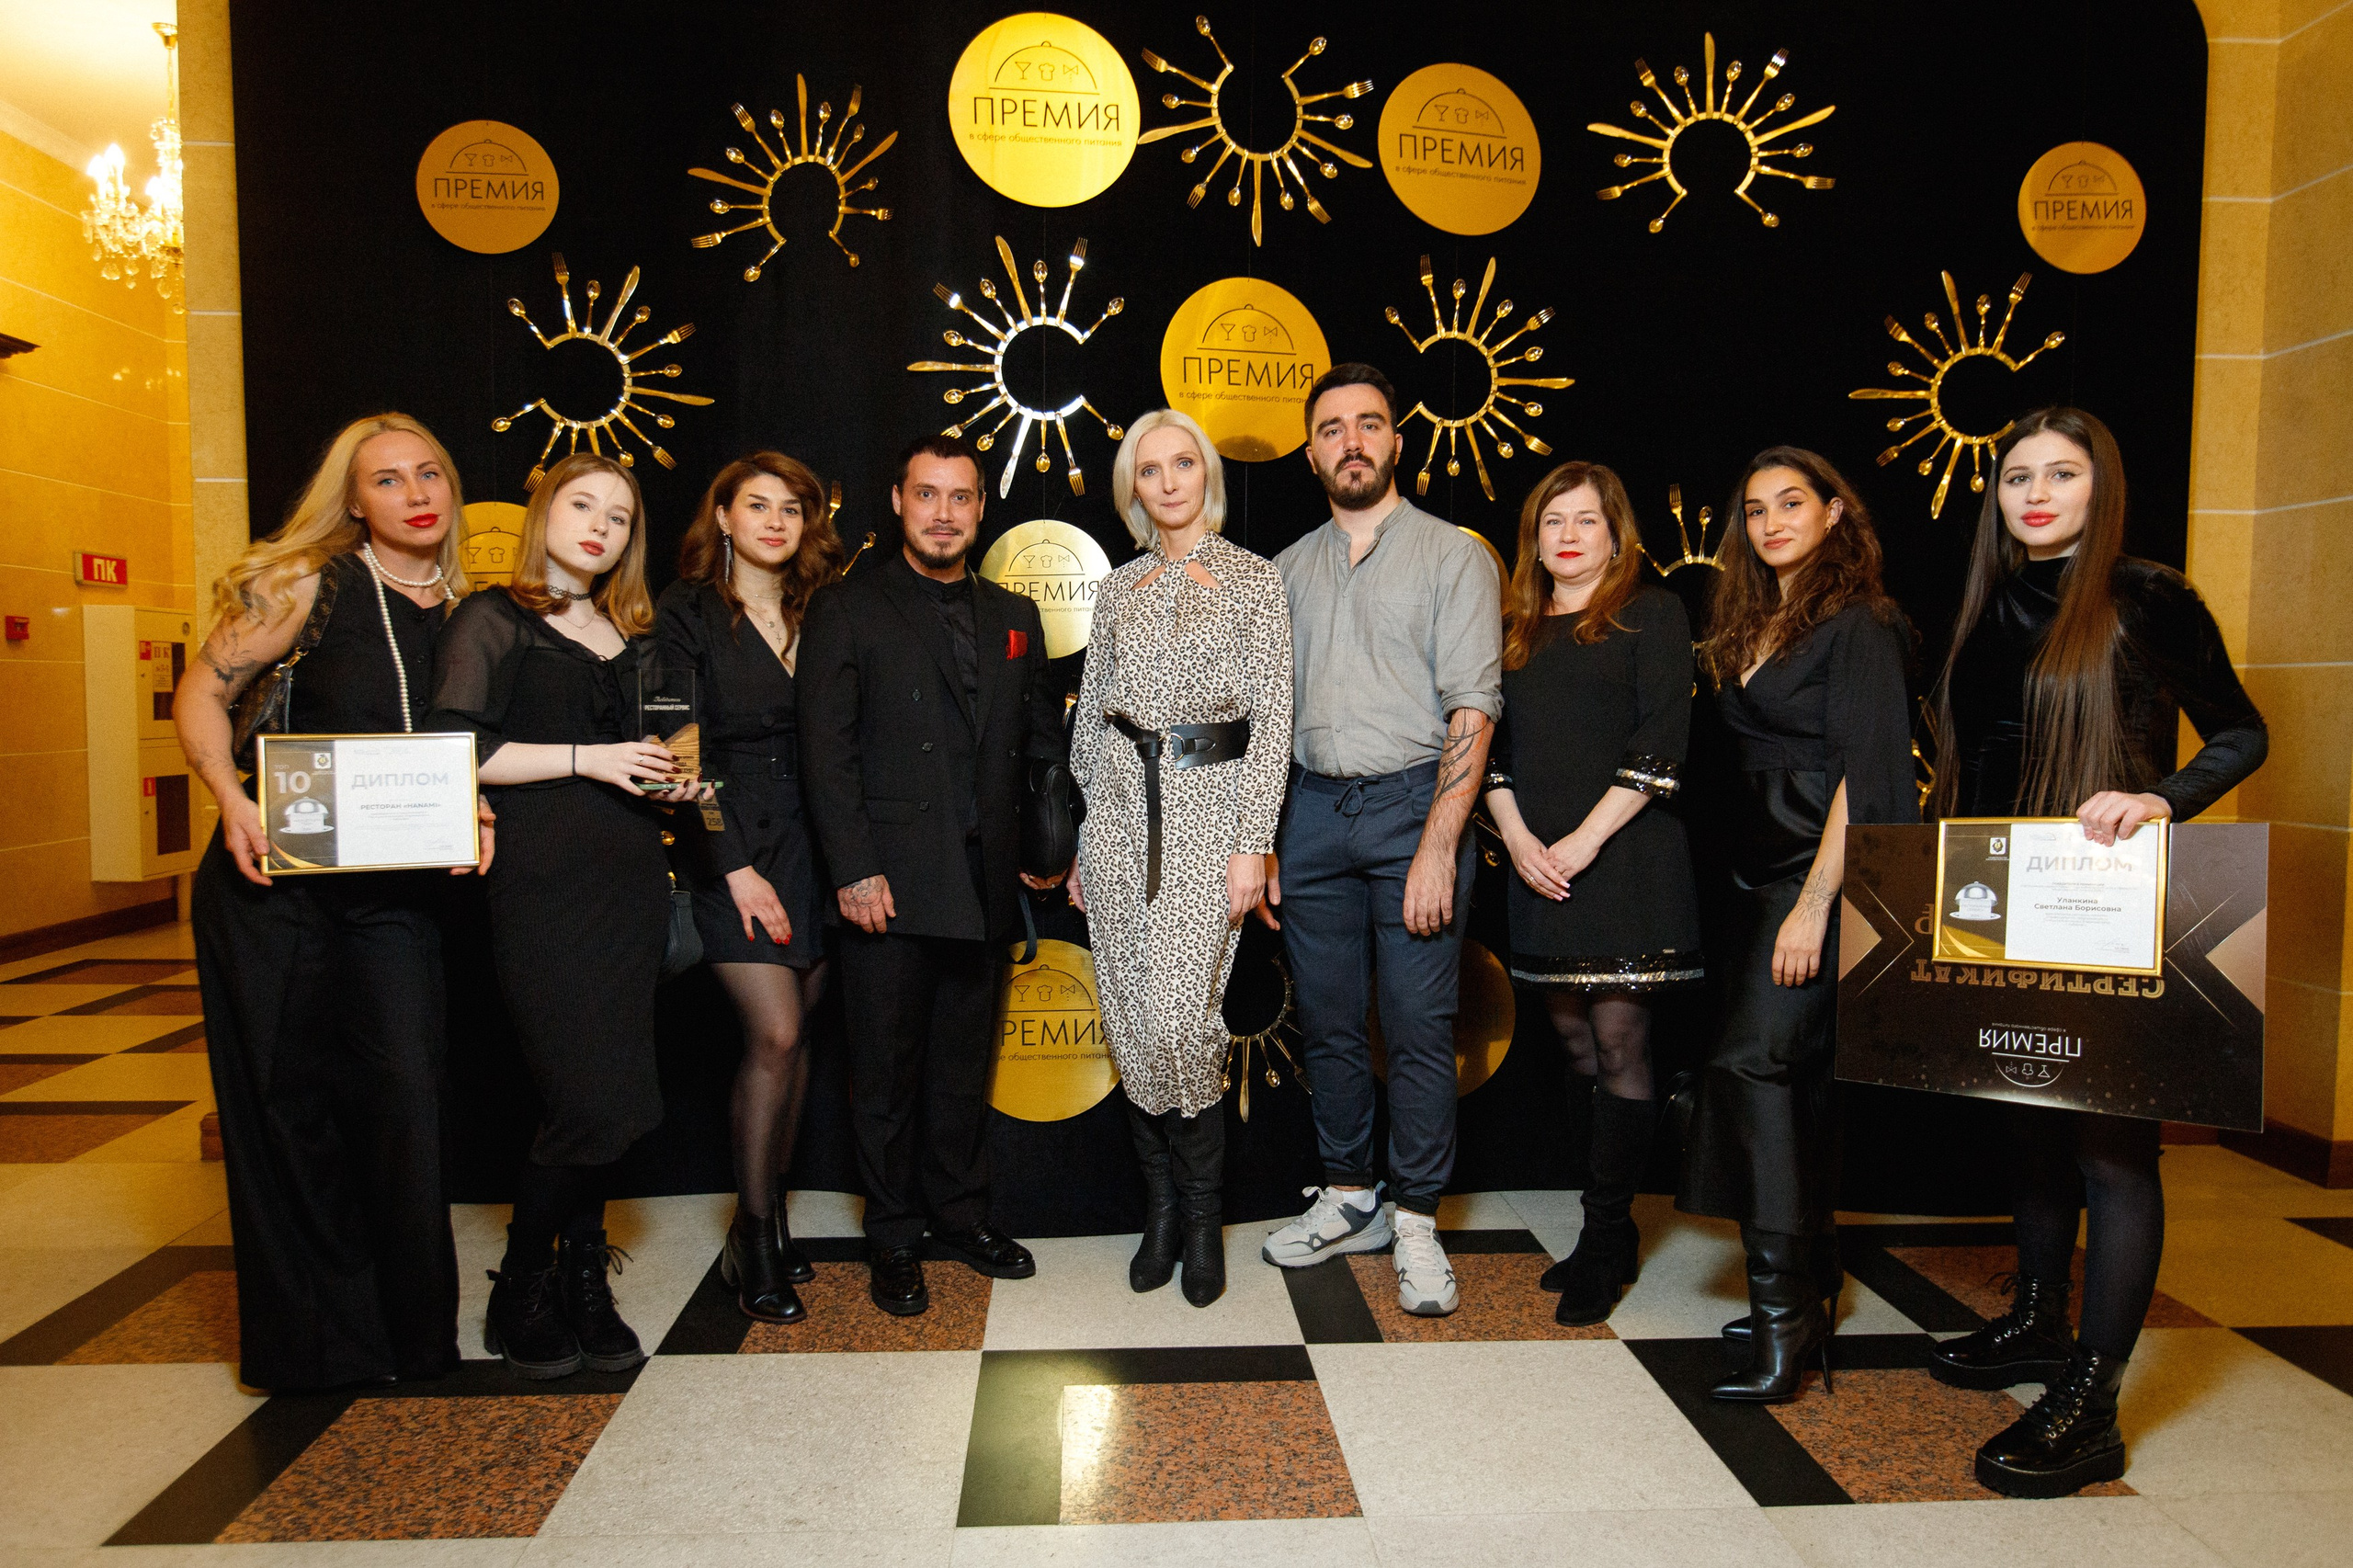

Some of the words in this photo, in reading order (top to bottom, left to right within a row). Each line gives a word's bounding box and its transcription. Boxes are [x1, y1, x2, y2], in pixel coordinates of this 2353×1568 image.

[973, 97, 1120, 131] ПРЕМИЯ
[977, 131, 1006, 142] сфере
[1008, 132, 1082, 146] общественного
[1084, 139, 1122, 147] питания
[1399, 133, 1525, 172] ПРЕМИЯ
[1402, 165, 1427, 176] сфере
[1429, 167, 1492, 182] общественного
[434, 177, 544, 200] ПРЕМИЯ
[2034, 199, 2133, 221] ПРЕМИЯ
[1183, 357, 1314, 390] ПРЕМИЯ
[1187, 391, 1212, 401] сфере
[1215, 392, 1280, 403] общественного
[92, 557, 119, 583] ПК
[274, 770, 312, 794] 10
[351, 772, 449, 790] ДИПЛОМ
[2026, 856, 2132, 873] ДИПЛОМ
[2033, 903, 2074, 911] Светлана
[2075, 904, 2122, 913] Борисовна
[2056, 896, 2099, 905] Уланкина
[1911, 959, 2165, 999] СЕРТИФИКАТ
[999, 1018, 1107, 1047] РЕМИ
[1979, 1028, 2082, 1058] ПРЕМИЯ
[1008, 1051, 1078, 1062] общественного
